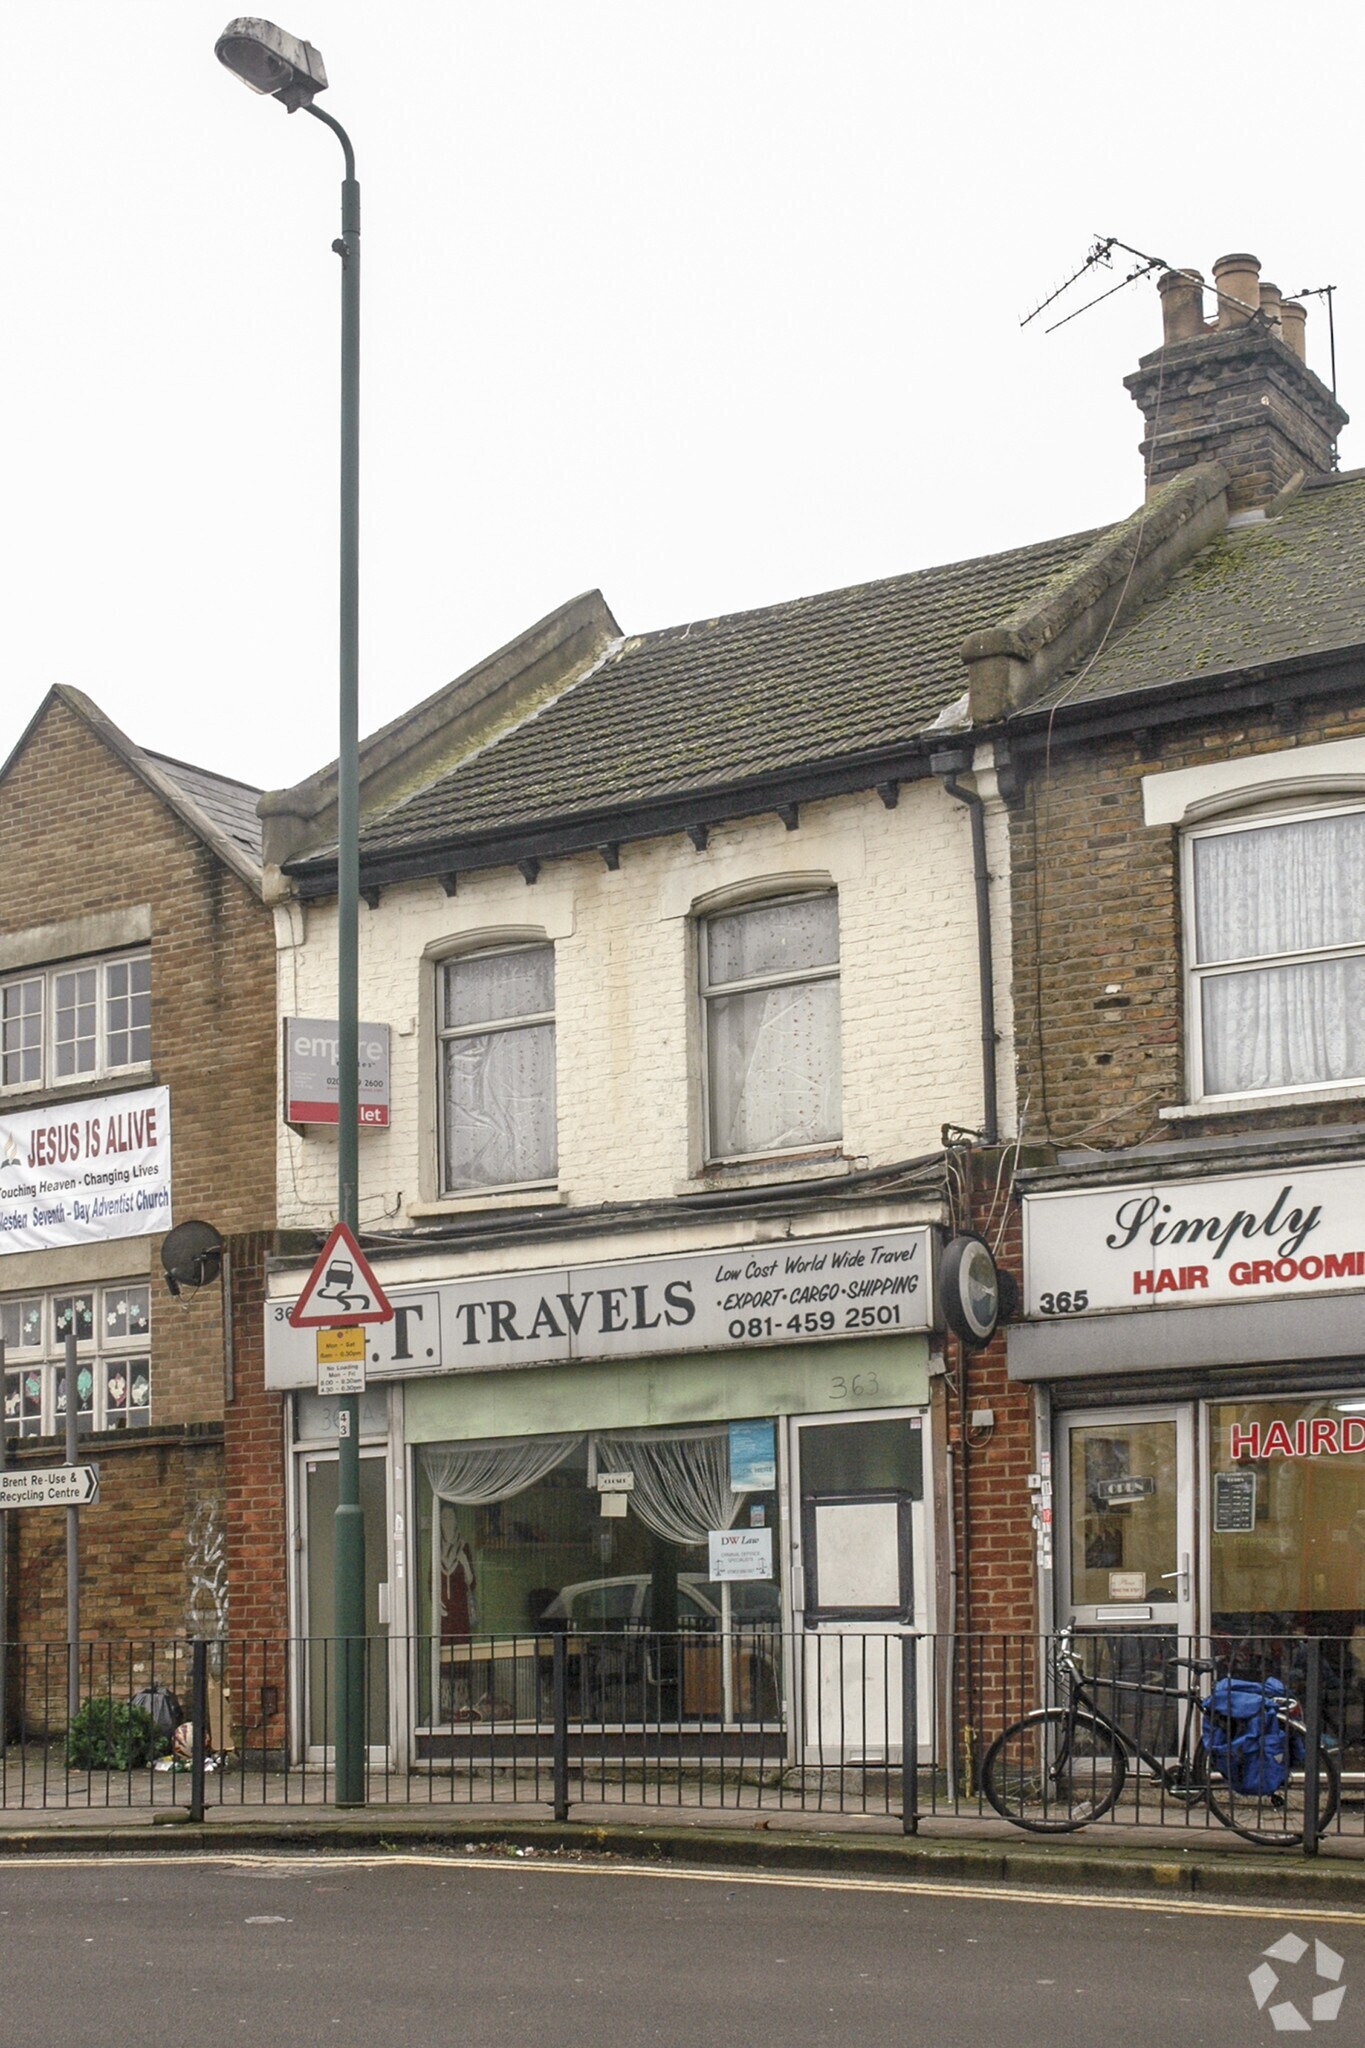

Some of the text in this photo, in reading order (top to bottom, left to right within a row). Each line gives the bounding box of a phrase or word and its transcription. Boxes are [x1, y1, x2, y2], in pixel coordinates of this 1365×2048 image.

[294, 1036, 384, 1066] empre
[364, 1079, 384, 1088] 2600
[360, 1106, 382, 1122] let
[27, 1107, 158, 1169] JESUS IS ALIVE
[39, 1177, 76, 1194] Heaven
[83, 1168, 130, 1187] Changing
[132, 1164, 159, 1178] Lives
[32, 1202, 66, 1227] Seventh
[73, 1199, 91, 1225] Day
[92, 1192, 134, 1219] Adventist
[136, 1185, 169, 1212] Church
[1106, 1185, 1323, 1260] Simply
[715, 1243, 918, 1283] Low Cost World Wide Travel
[1133, 1251, 1365, 1295] HAIR GROOMI
[455, 1279, 696, 1346] TRAVELS
[1039, 1290, 1089, 1314] 365
[728, 1304, 901, 1339] 081-459 2501
[828, 1371, 879, 1399] 363
[1230, 1416, 1365, 1459] HAIRD
[2, 1471, 77, 1488] Brent Re-Use &
[1107, 1482, 1145, 1495] OPEN
[0, 1487, 80, 1503] Recycling Centre
[721, 1535, 760, 1546] DW Law
